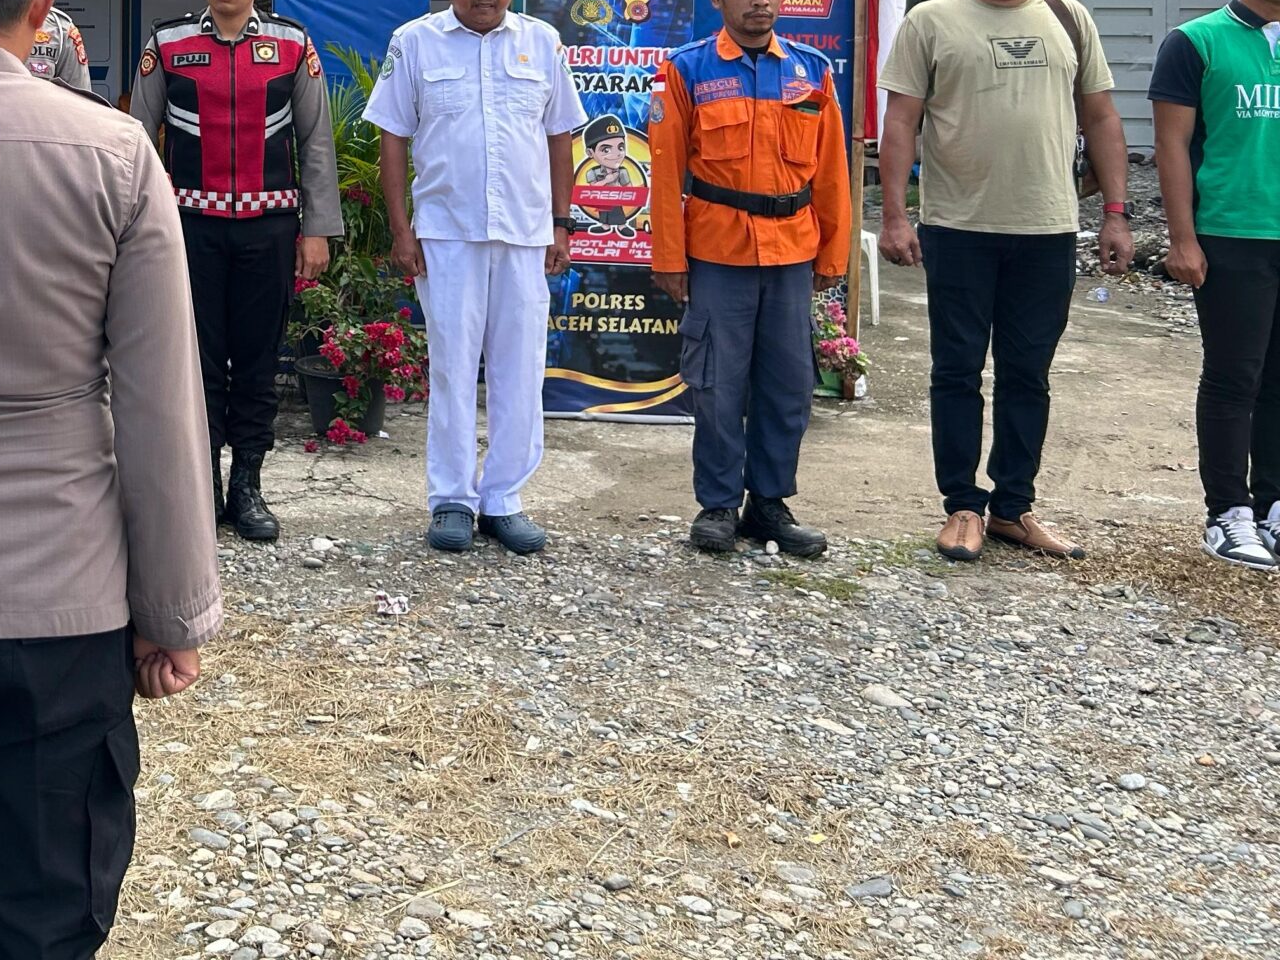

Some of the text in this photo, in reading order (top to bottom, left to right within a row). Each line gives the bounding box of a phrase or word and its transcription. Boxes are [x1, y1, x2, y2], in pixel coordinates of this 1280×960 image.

[176, 54, 207, 65] PUJI
[608, 49, 670, 67] UNTU
[696, 79, 740, 93] RESCUE
[1236, 109, 1280, 119] VIA MONTE
[580, 189, 637, 201] PRESISI
[569, 239, 629, 249] HOTLINE
[570, 247, 620, 257] POLRI
[572, 292, 646, 311] POLRES
[546, 315, 679, 335] ACEH SELATAN
